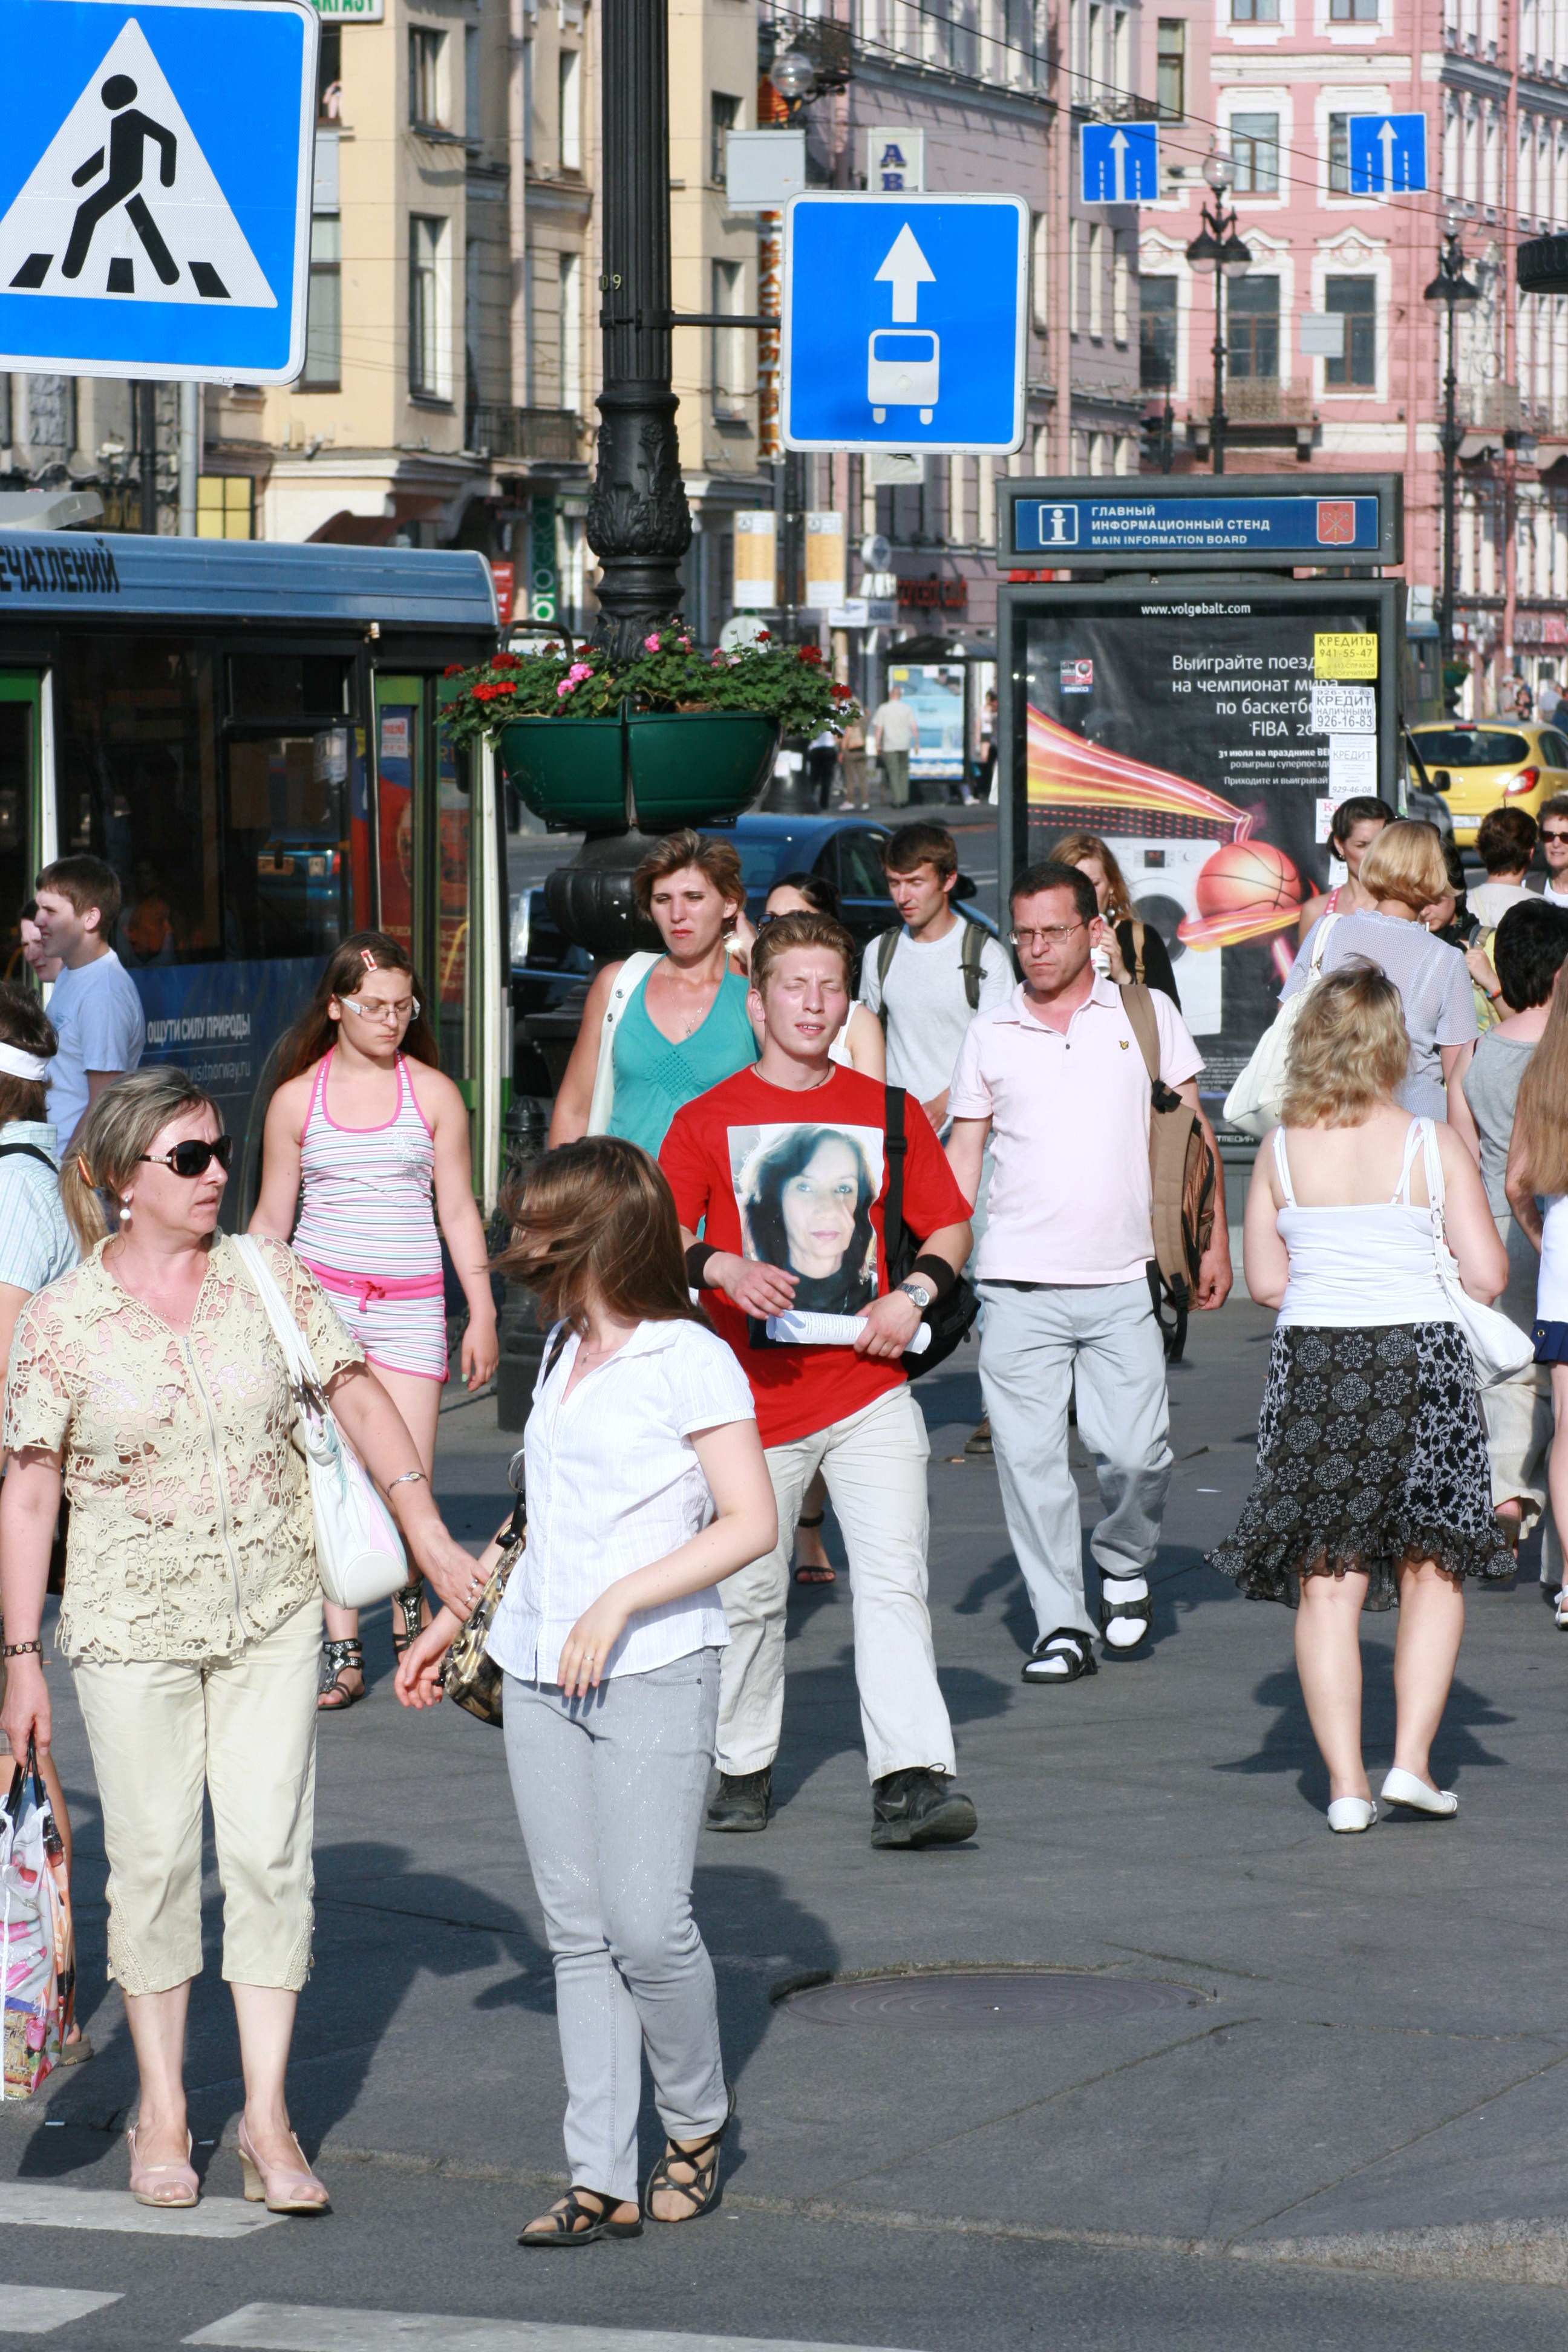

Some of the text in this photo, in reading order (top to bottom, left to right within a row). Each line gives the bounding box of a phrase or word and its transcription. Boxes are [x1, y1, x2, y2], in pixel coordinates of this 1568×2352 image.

[1091, 505, 1155, 516] ГЛАВНЫЙ
[1091, 518, 1270, 531] ИНФОРМАЦИОННЫЙ СТЕНД
[1091, 535, 1247, 544] MAIN INFORMATION BOARD
[1141, 603, 1251, 617] www.volgobalt.com
[1319, 636, 1374, 647] КРЕДИТЫ
[1320, 649, 1373, 658] 941-55-47
[1172, 655, 1263, 673] Выиграйте
[1172, 680, 1192, 693] на
[1197, 679, 1290, 693] чемпионат
[1317, 696, 1371, 707] КРЕДИТ
[1217, 702, 1237, 715] по
[1317, 716, 1372, 727] 926-16-83
[1252, 721, 1289, 737] FIBA
[1218, 750, 1228, 759] 31
[1267, 750, 1315, 759] празднике
[1333, 750, 1373, 761] КРЕДИТ
[1230, 760, 1275, 770] розыгрыш
[1224, 776, 1271, 786] Приходите
[1280, 777, 1330, 786] выигрывай
[147, 1013, 250, 1047] ОЩУТИ СИЛУ ПРИРОДЫ
